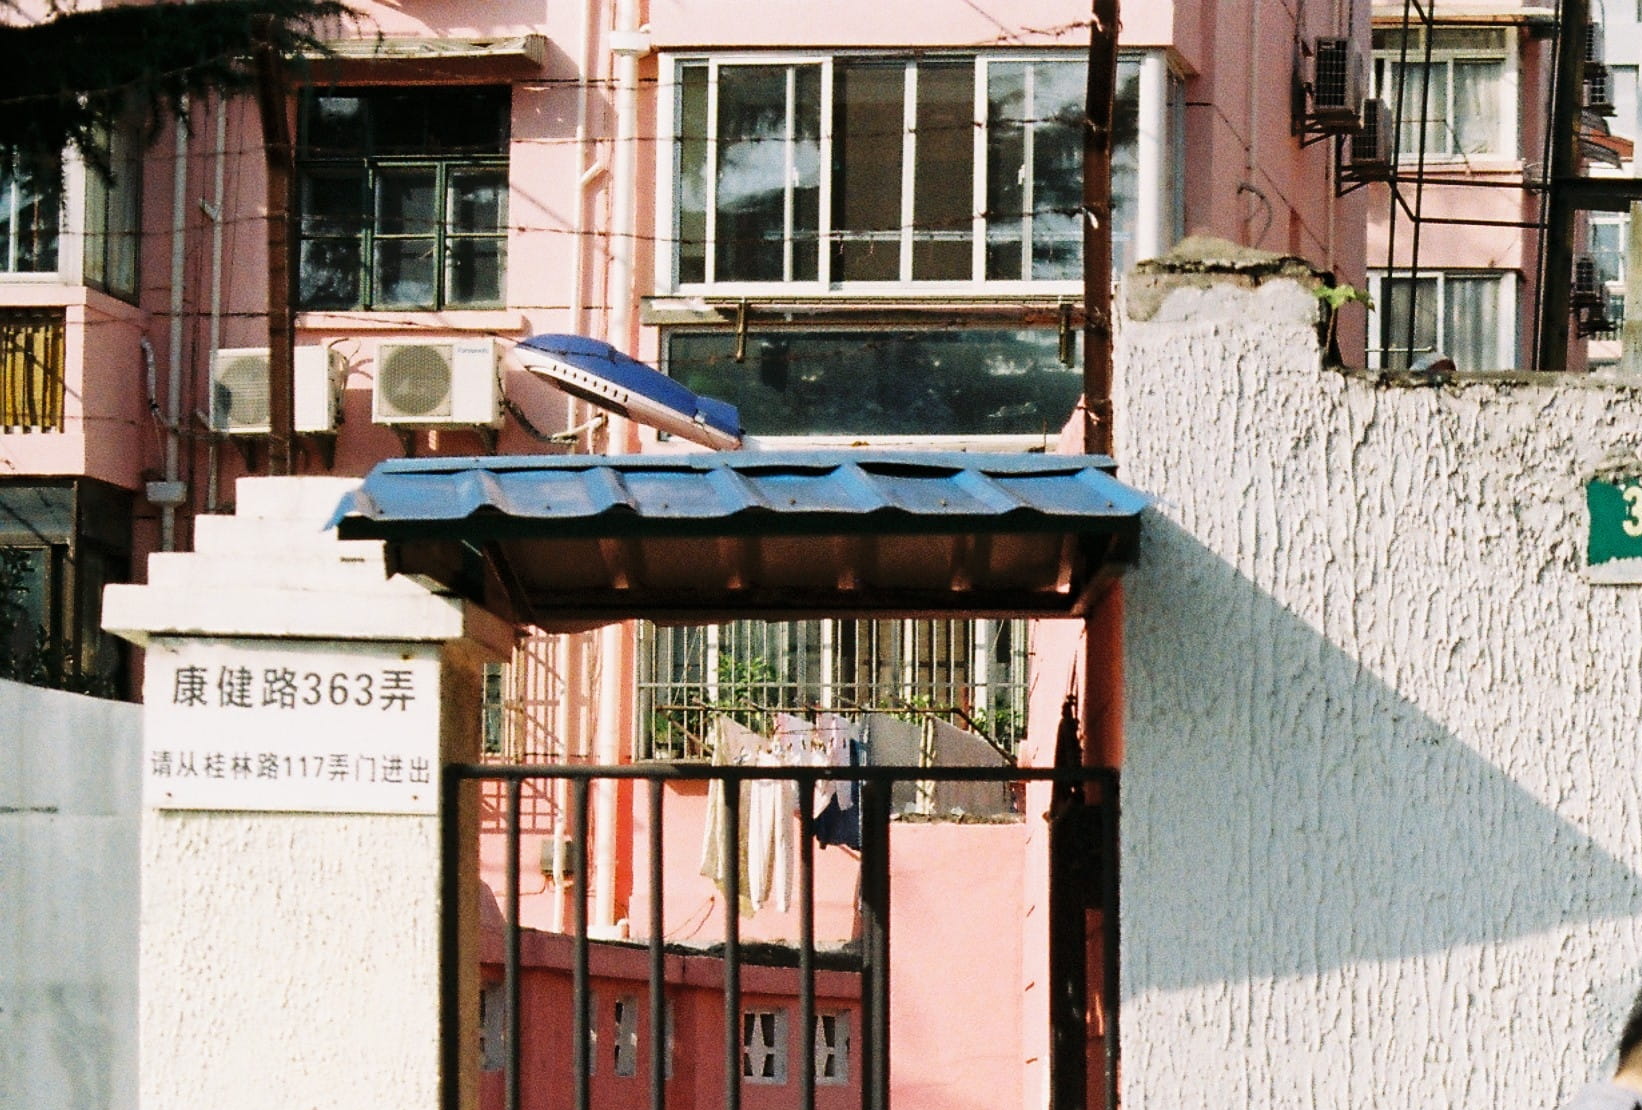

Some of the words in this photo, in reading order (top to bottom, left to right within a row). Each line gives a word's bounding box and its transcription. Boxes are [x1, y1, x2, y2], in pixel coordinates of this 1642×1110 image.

[173, 664, 416, 712] 康健路363弄
[151, 750, 431, 785] 请从桂林路117弄门进出
